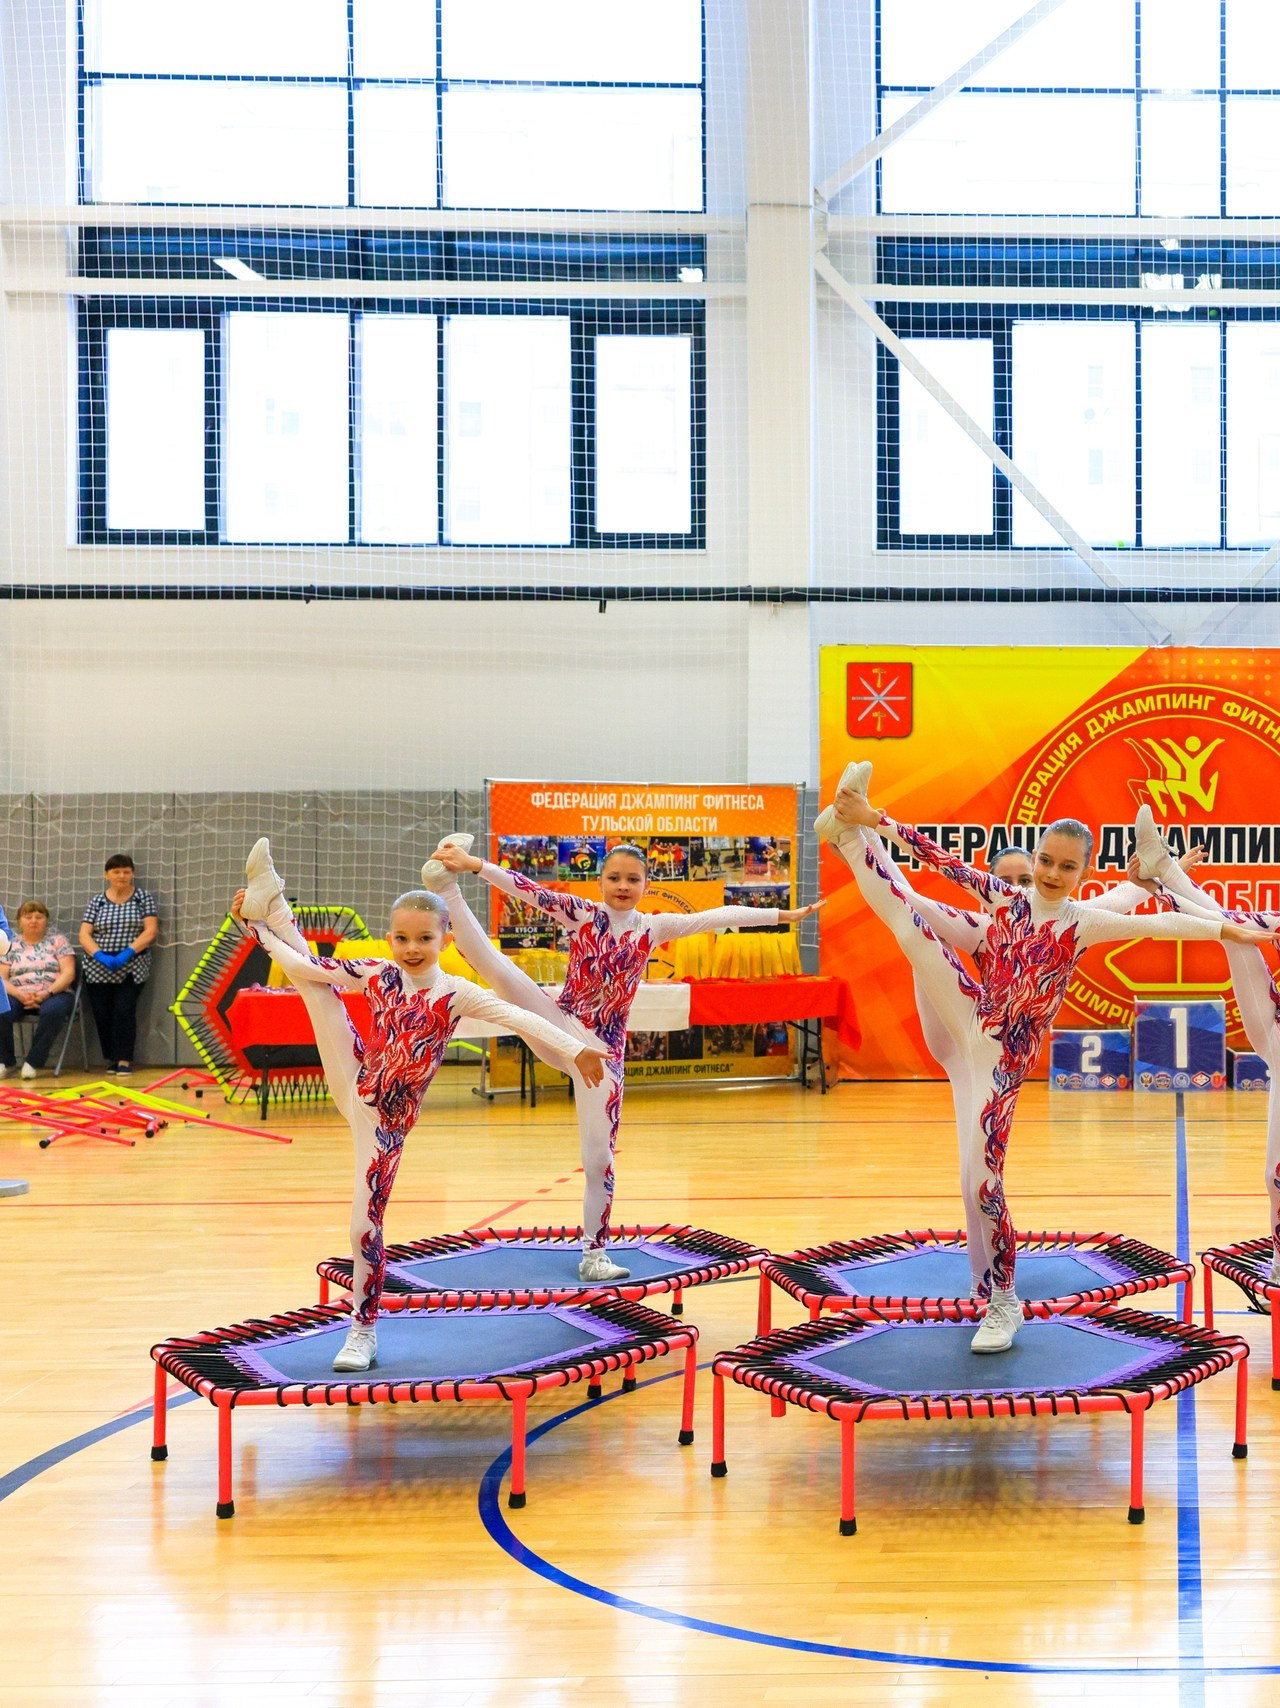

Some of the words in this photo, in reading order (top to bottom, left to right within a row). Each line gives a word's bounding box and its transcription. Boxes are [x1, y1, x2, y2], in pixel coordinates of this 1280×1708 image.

[1016, 731, 1084, 826] ДЕРАЦИЯ
[1085, 693, 1217, 740] ДЖАМПИНГ
[530, 791, 617, 810] ФЕДЕРАЦИЯ
[619, 793, 700, 811] ДЖАМПИНГ
[702, 794, 765, 811] ФИТНЕСА
[581, 814, 655, 833] ТУЛЬСКОЙ
[656, 815, 718, 833] ОБЛАСТИ
[1066, 980, 1135, 1027] JUMPI
[1081, 1035, 1102, 1073] 2
[1169, 1007, 1188, 1069] 1
[645, 1064, 692, 1077] ДЖАМПИНГ
